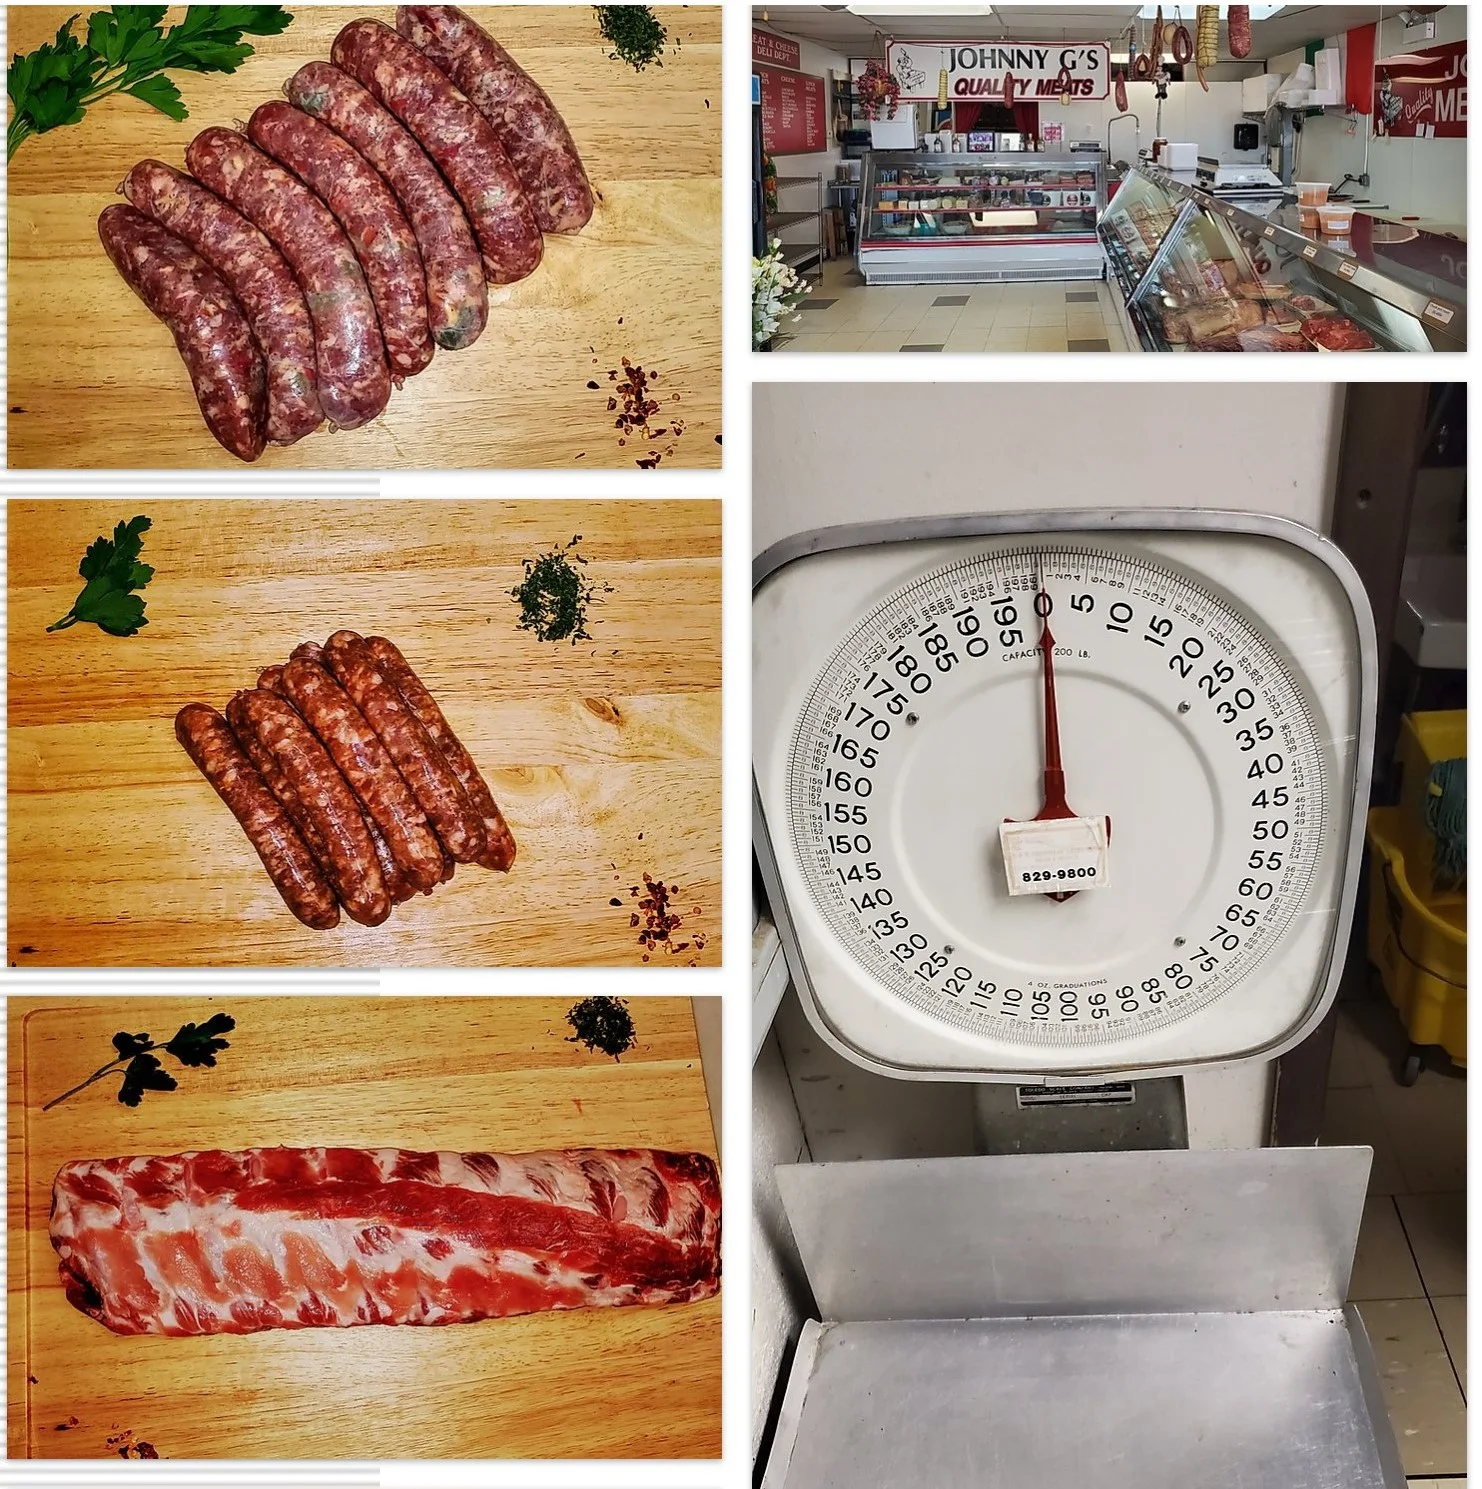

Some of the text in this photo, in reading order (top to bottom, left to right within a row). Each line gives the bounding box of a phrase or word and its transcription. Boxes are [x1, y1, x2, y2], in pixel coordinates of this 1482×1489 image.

[757, 46, 773, 58] DELI
[776, 41, 798, 56] CHEESE
[949, 48, 1099, 73] JOHNNY G'S
[954, 78, 1034, 96] QUALTY
[1405, 87, 1433, 119] Quality
[1033, 592, 1053, 618] 0
[1070, 594, 1095, 614] 5
[991, 596, 1024, 648] 195
[1106, 602, 1133, 634] 10
[951, 605, 989, 658] 190
[1143, 614, 1173, 648] 15
[917, 622, 960, 673] 185
[1002, 648, 1091, 662] CAPACIT 200 LB.
[1168, 637, 1204, 679] 20
[886, 644, 932, 694] 180
[1198, 659, 1235, 700] 25
[863, 671, 909, 716] 175
[1216, 687, 1255, 724] 30
[844, 701, 891, 741] 170
[1235, 717, 1274, 752] 35
[832, 733, 880, 769] 165
[1247, 753, 1284, 780] 40
[825, 767, 873, 798] 160
[1251, 786, 1289, 809] 45
[809, 813, 823, 821] 154
[810, 821, 823, 829] 153
[823, 802, 868, 826] 155
[1294, 818, 1305, 826] 49
[1252, 819, 1289, 841] 50
[827, 834, 872, 855] 150
[1248, 849, 1284, 871] 55
[836, 861, 882, 886] 145
[1022, 867, 1096, 882] 829-9800
[1238, 877, 1273, 901] 60
[1225, 903, 1260, 927] 65
[1209, 925, 1240, 951] 70
[1189, 946, 1219, 973] 75
[1053, 978, 1108, 989] GRADUATIONS
